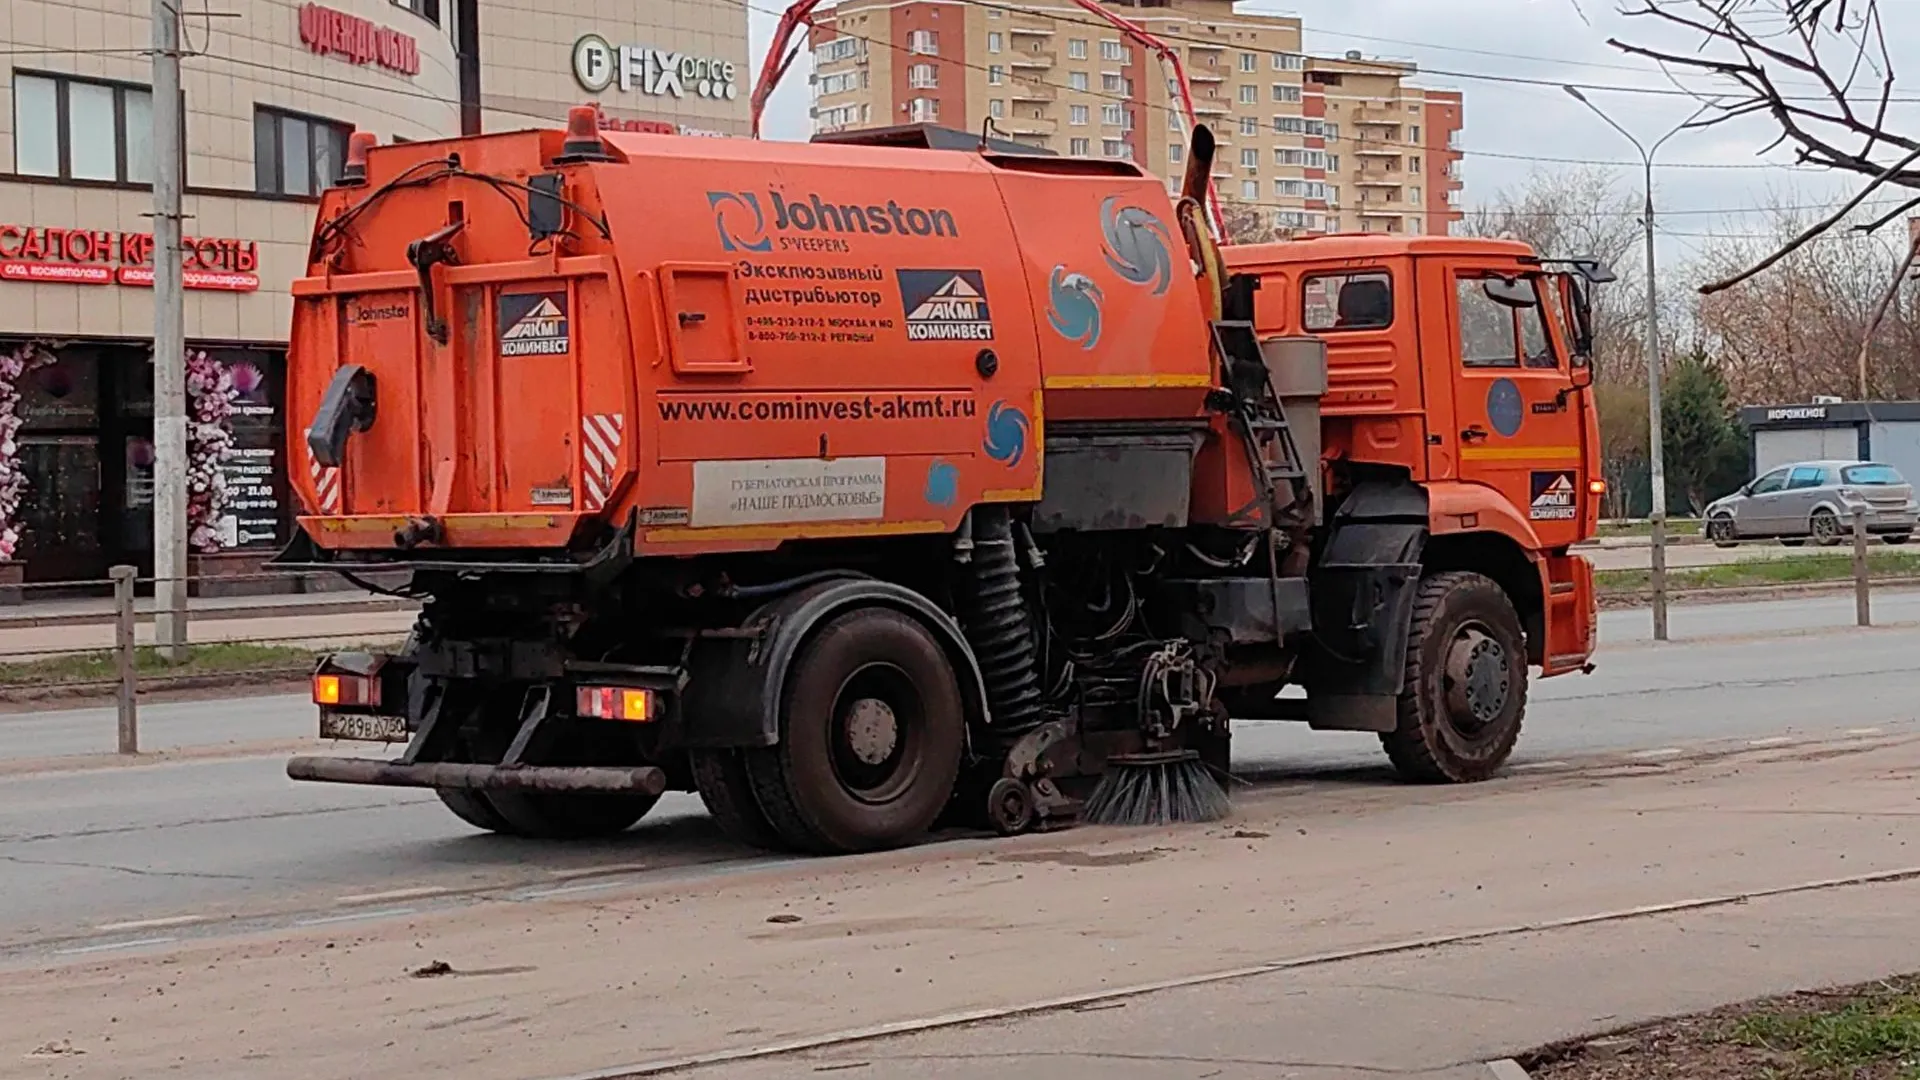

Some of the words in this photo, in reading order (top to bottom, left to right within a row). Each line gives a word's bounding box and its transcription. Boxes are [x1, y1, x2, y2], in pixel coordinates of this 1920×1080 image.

[299, 2, 377, 64] ОДЕЖДА
[377, 25, 420, 76] ОБУВЬ
[681, 56, 736, 83] price
[768, 184, 959, 238] Johnston
[0, 224, 113, 262] САЛОН
[120, 232, 258, 272] КРСОТЫ
[779, 236, 850, 252] SWEEPERS
[739, 260, 883, 281] Эксклюзивный
[907, 323, 992, 340] КОМИНВЕСТ
[502, 340, 568, 355] КОМИНВЕСТ
[658, 396, 976, 421] www.cominvest-akmt.ru
[1768, 407, 1826, 420] МОРОЖЕНОЕ
[731, 475, 821, 491] ГУБЕРНАТОРСКАЯ
[823, 472, 883, 487] ПРОГРАММА
